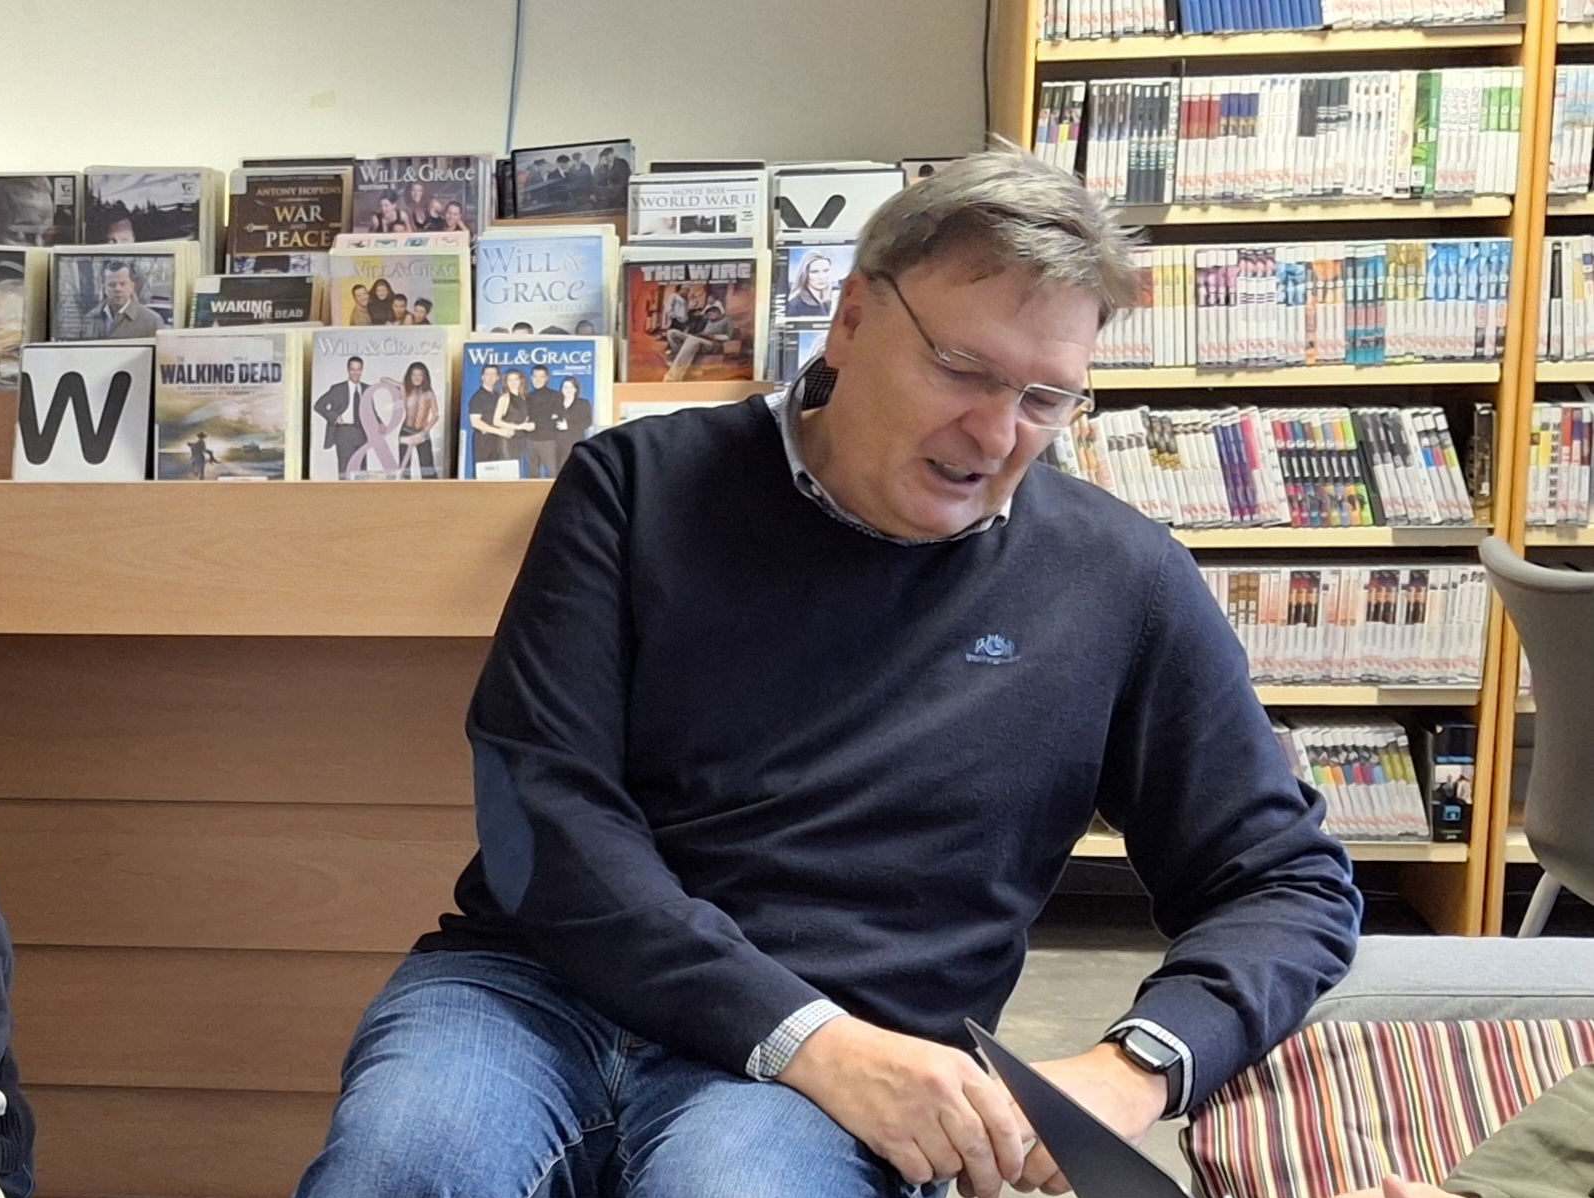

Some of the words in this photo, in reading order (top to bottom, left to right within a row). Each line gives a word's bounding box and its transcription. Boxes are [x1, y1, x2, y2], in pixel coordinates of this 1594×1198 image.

[639, 195, 700, 208] WORLD
[705, 195, 741, 206] WAR
[274, 205, 325, 222] WAR
[266, 231, 331, 249] PEACE
[641, 265, 686, 282] THE
[688, 263, 751, 280] WIRE
[210, 300, 273, 313] WAKING
[251, 310, 273, 320] THE
[274, 310, 304, 320] DEAD
[160, 363, 235, 385] WALKING
[238, 362, 282, 384] DEAD
[19, 370, 133, 466] W
